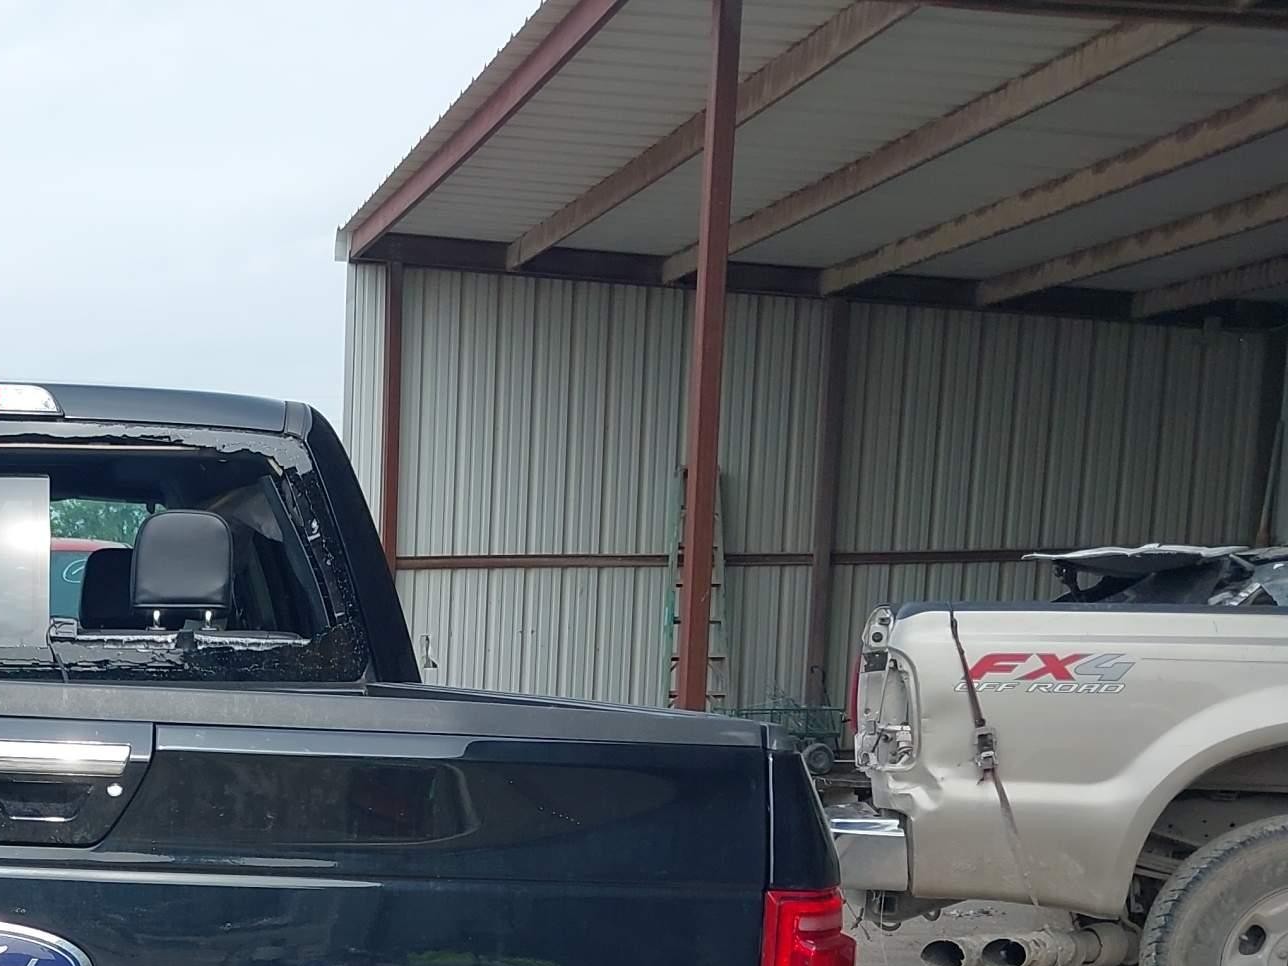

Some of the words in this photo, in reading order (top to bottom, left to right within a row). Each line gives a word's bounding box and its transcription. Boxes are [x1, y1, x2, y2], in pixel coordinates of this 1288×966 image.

[963, 652, 1136, 682] FX4
[954, 682, 1019, 692] OFF
[1026, 682, 1126, 693] ROAD
